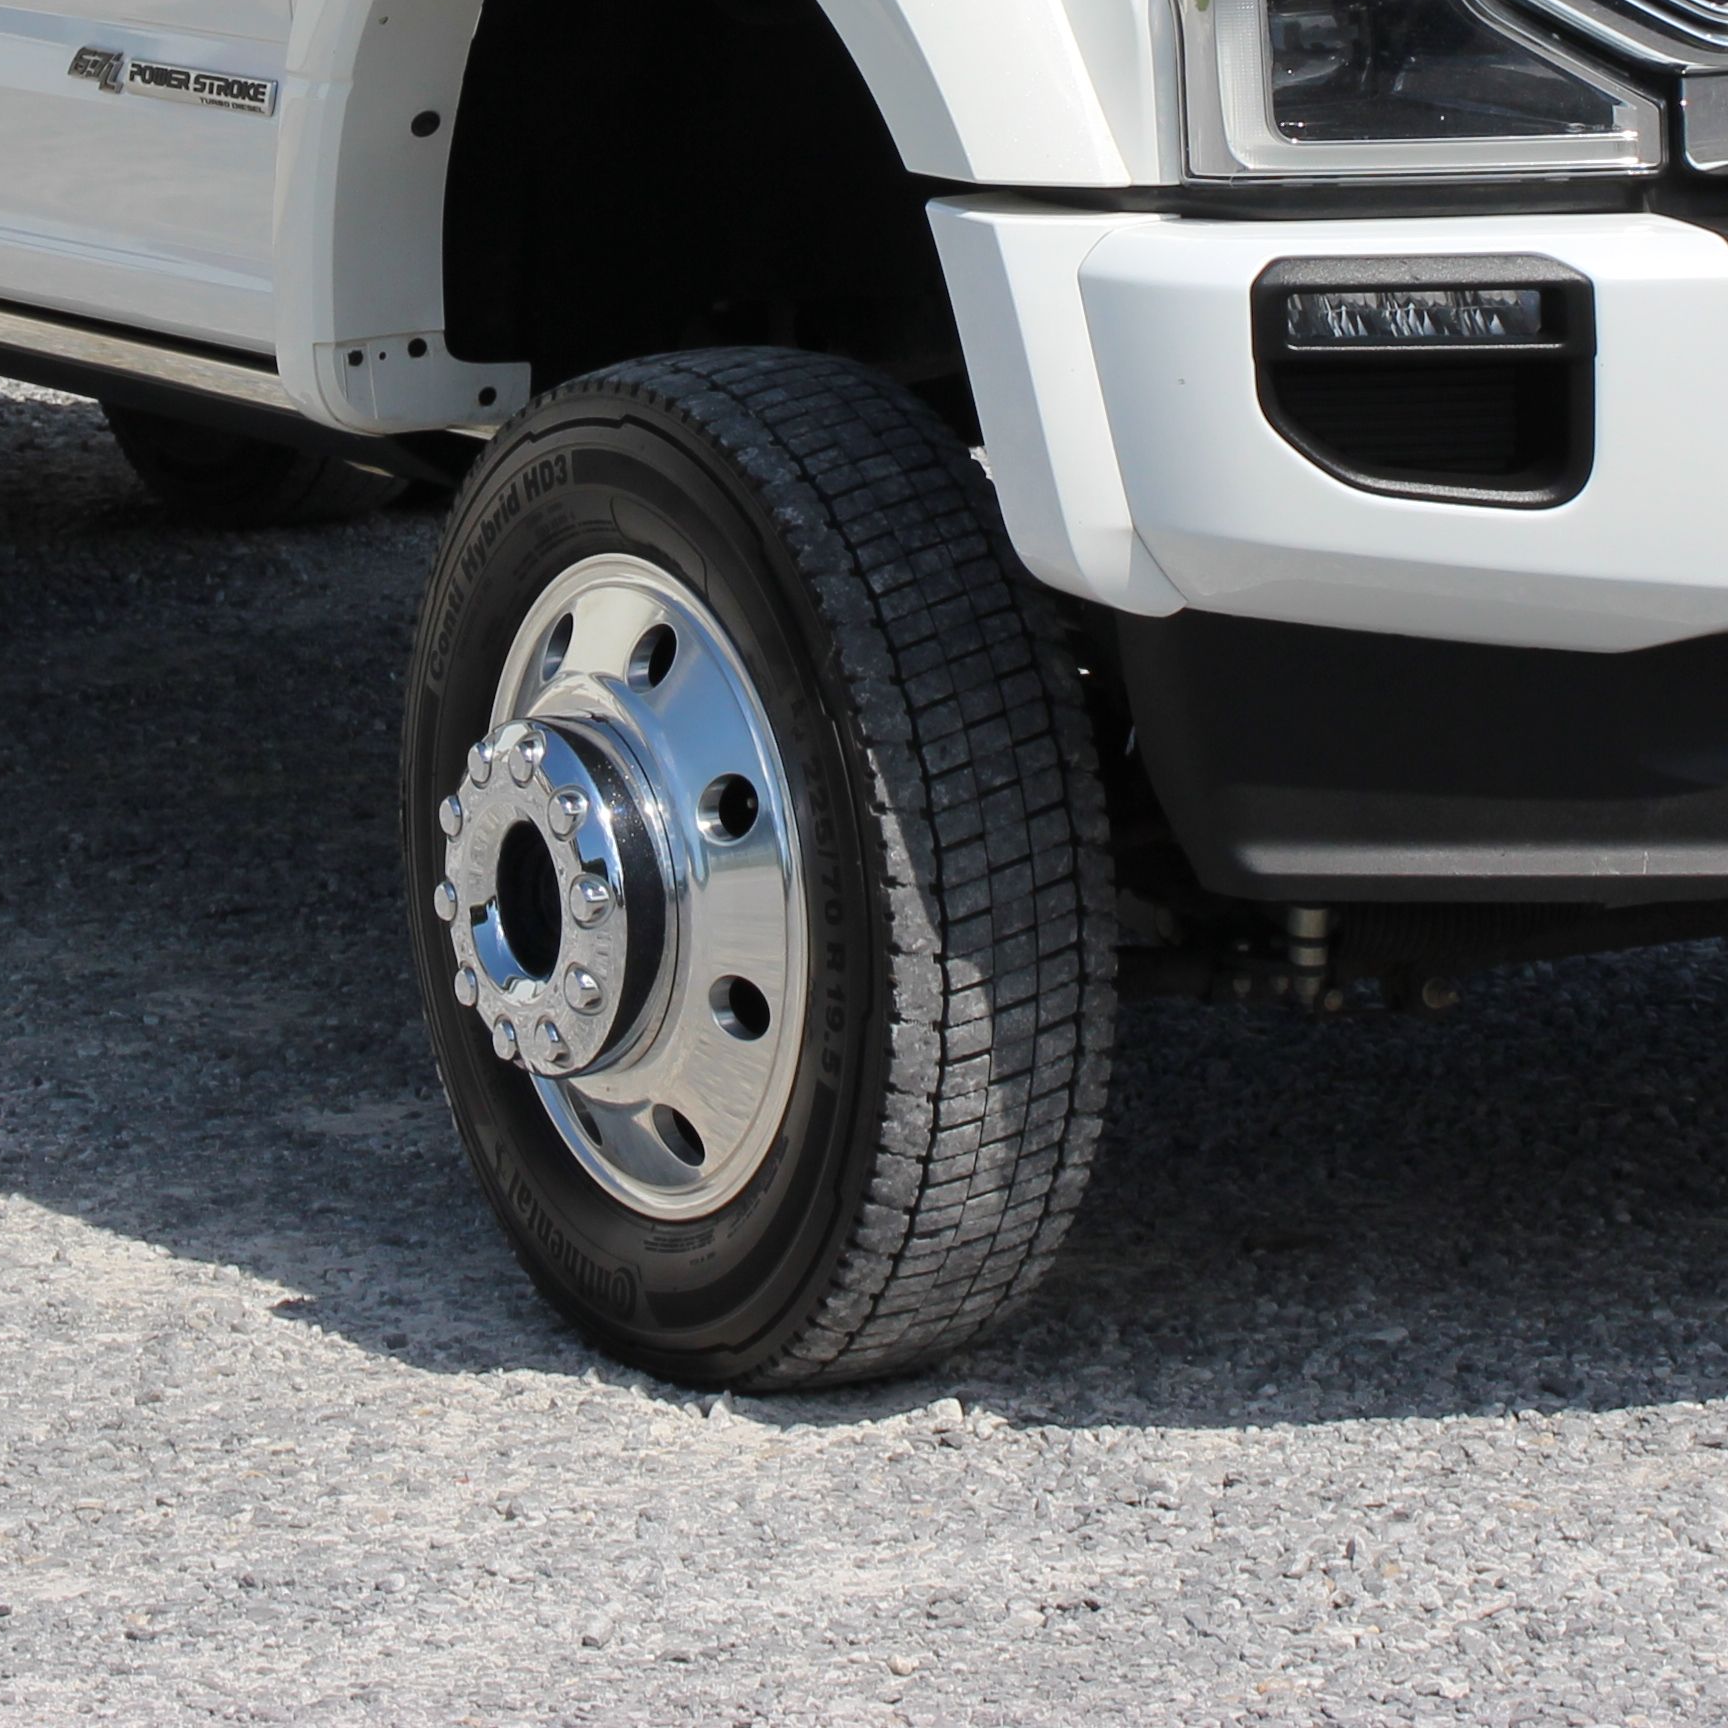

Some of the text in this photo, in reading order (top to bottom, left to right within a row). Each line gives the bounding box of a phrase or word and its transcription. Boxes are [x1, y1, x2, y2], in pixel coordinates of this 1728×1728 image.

[129, 62, 190, 91] POWER
[193, 74, 267, 103] STROKE
[199, 96, 265, 114] TURBO DIESEL
[429, 576, 465, 681] Conti
[460, 483, 521, 581] Hybrid
[522, 454, 569, 503] HD3
[802, 759, 847, 1079] 225/70 R 19.5
